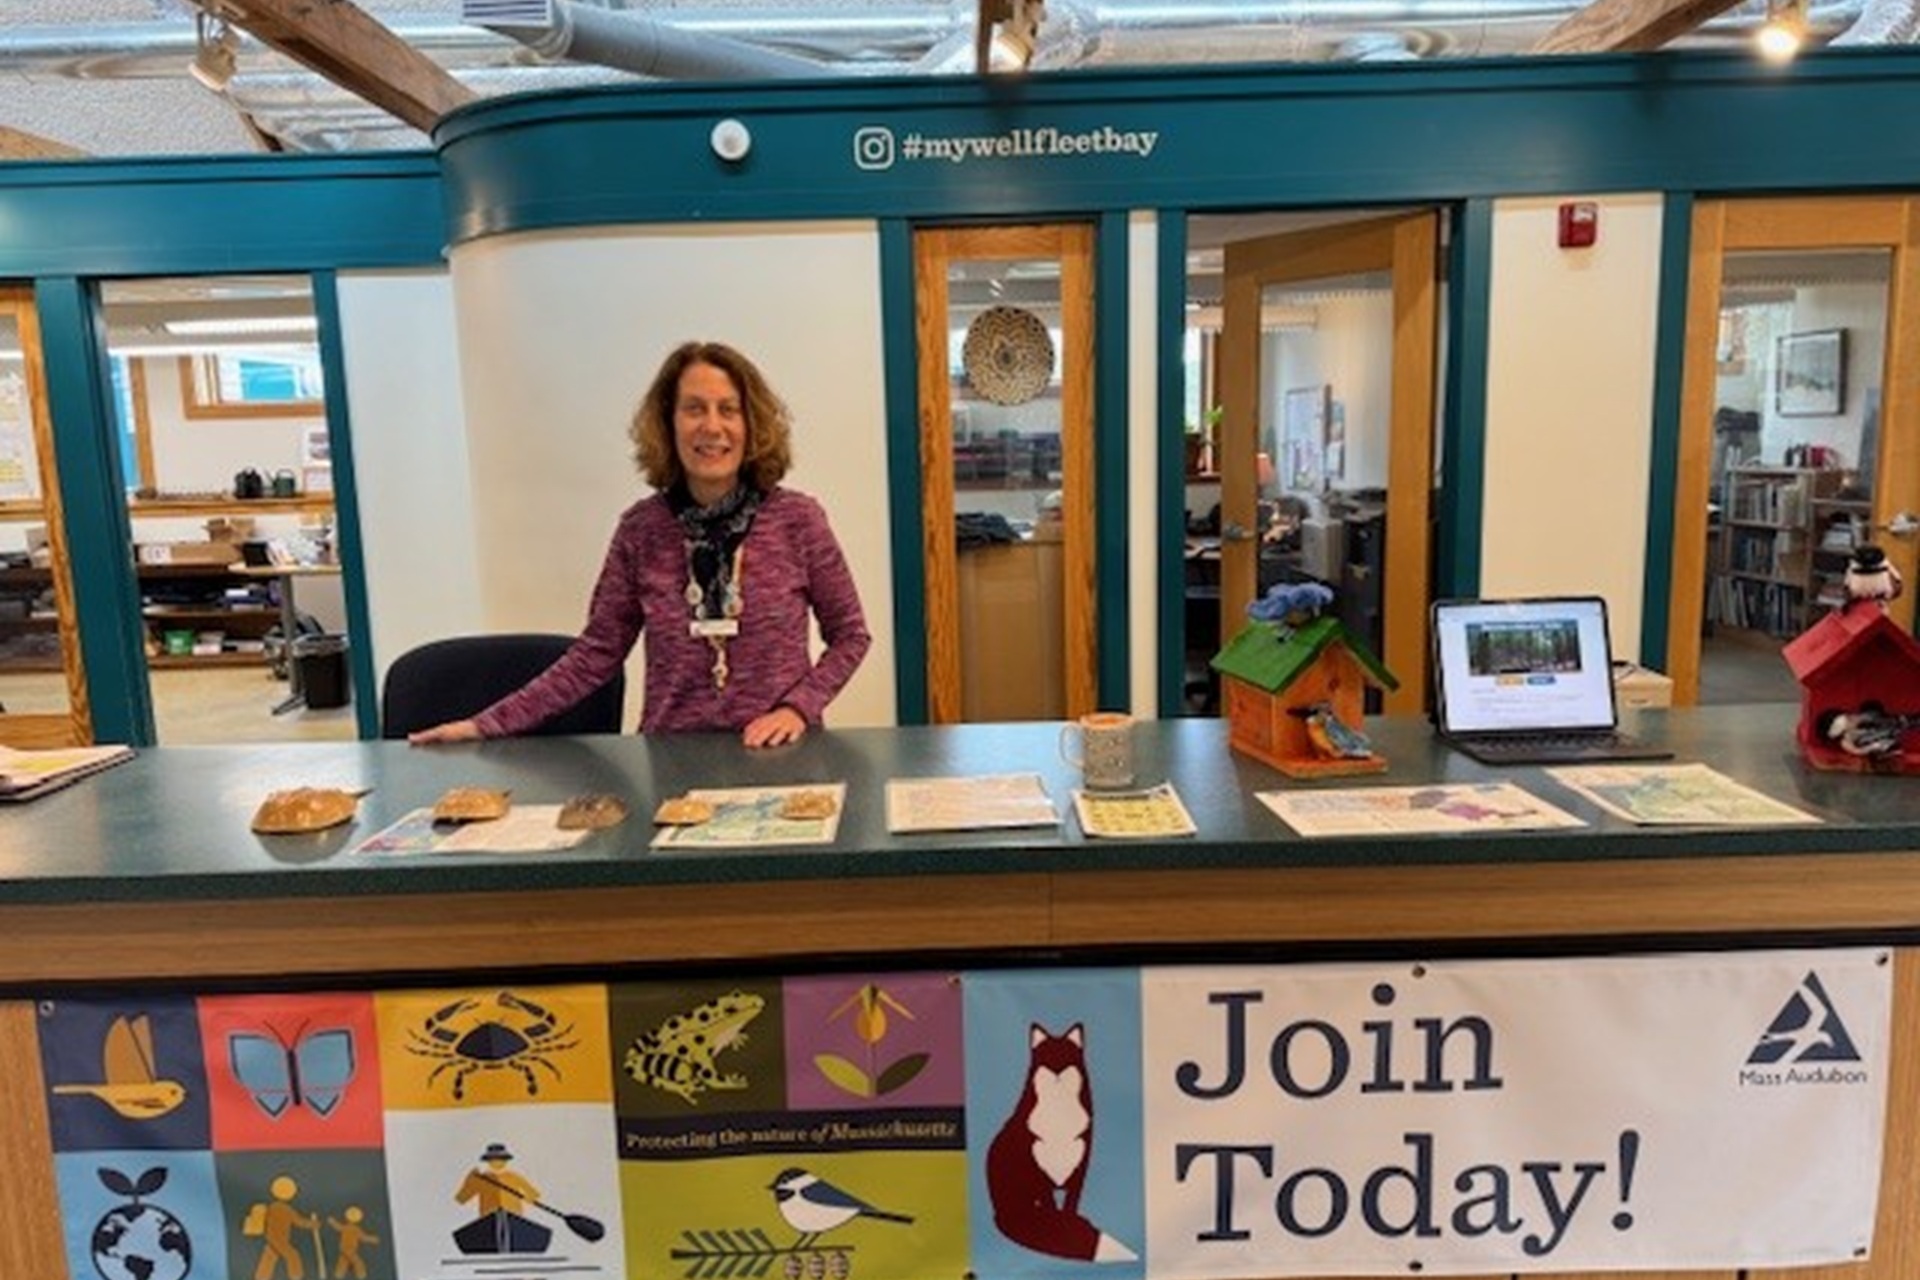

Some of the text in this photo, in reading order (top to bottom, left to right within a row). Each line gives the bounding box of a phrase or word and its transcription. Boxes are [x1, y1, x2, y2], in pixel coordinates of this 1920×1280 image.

[903, 127, 1158, 162] #mywellfleetbay
[1174, 983, 1504, 1099] Join
[1739, 1067, 1868, 1085] Mass Audubon
[626, 1131, 717, 1150] Protecting
[720, 1129, 747, 1145] the
[751, 1127, 804, 1143] nature
[811, 1124, 828, 1143] of
[1175, 1129, 1641, 1257] Today!
